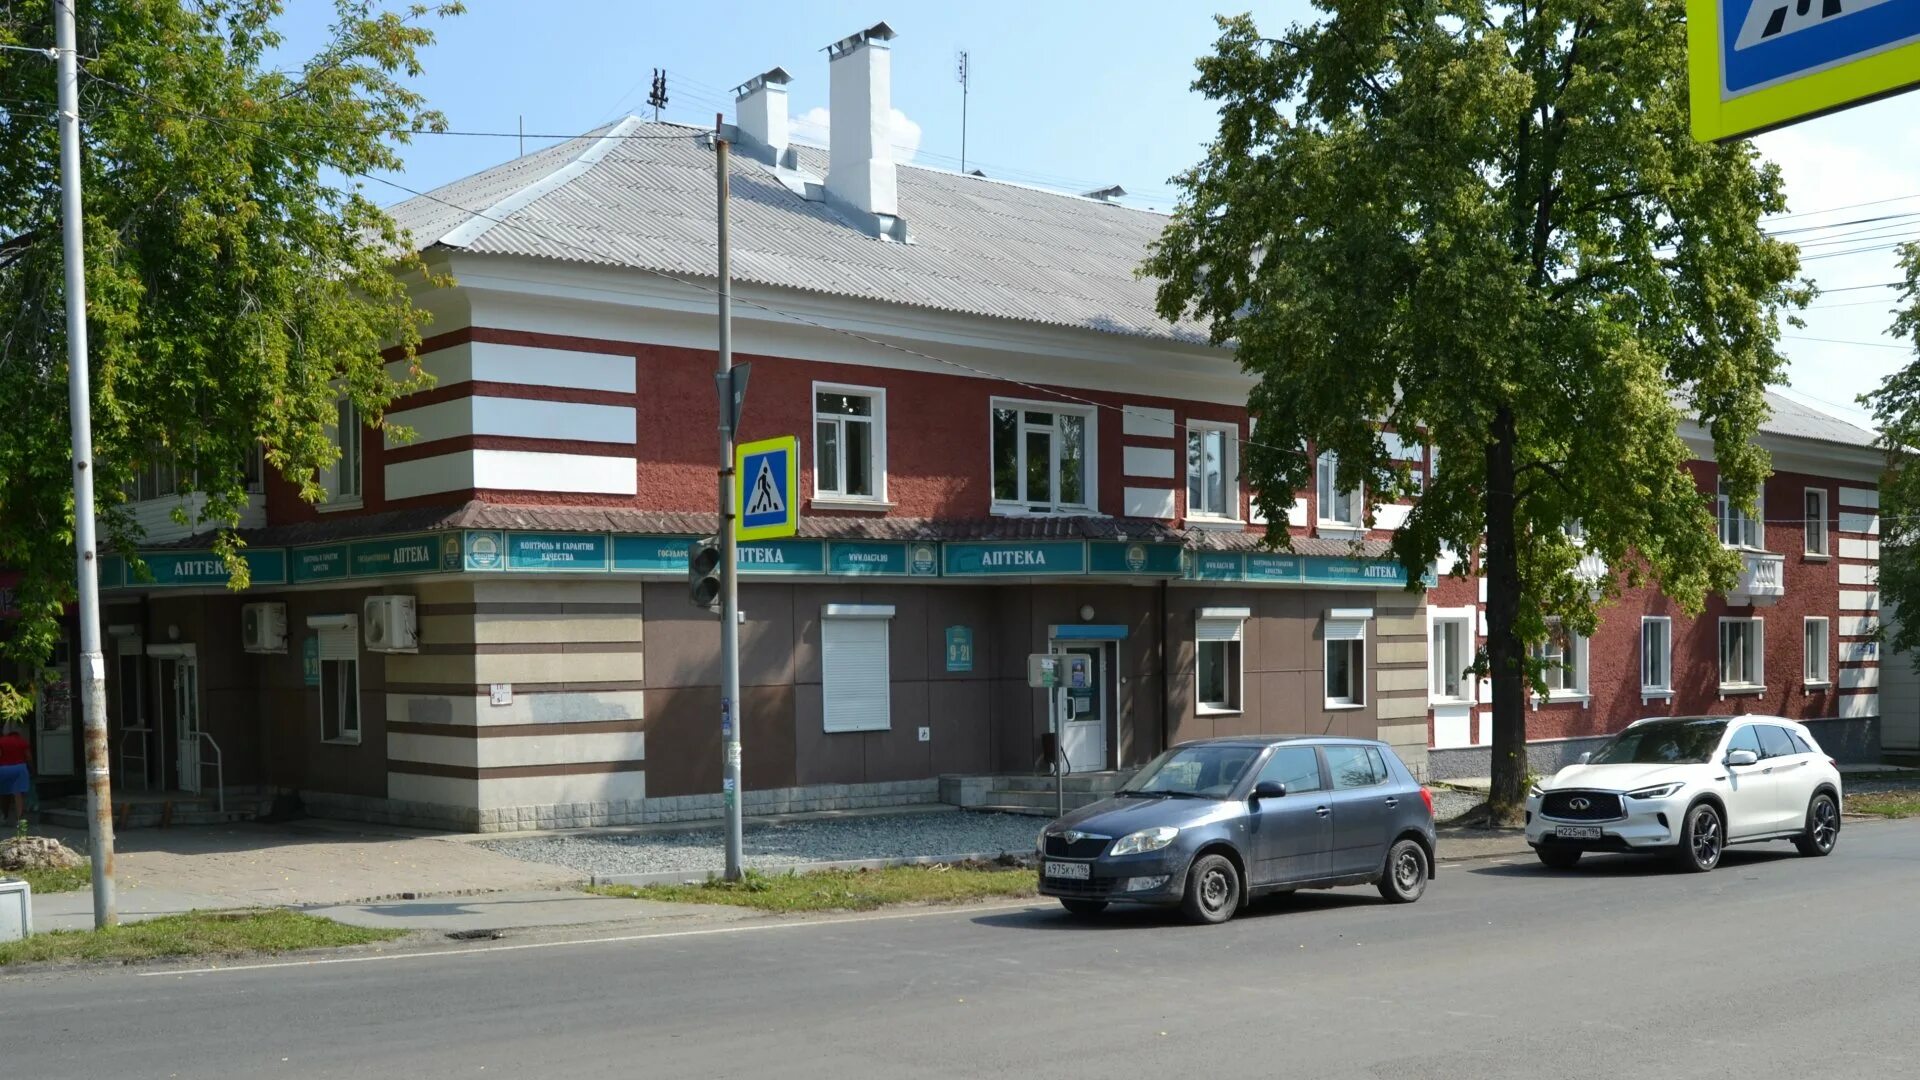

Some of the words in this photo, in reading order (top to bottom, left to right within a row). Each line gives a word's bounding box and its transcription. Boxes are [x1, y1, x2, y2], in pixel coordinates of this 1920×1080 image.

[520, 541, 554, 550] КОНТРОЛЬ
[556, 542, 560, 550] И
[563, 542, 594, 551] ГАРАНТИЯ
[393, 545, 429, 564] АПТЕКА
[541, 553, 574, 561] КАЧЕСТВА
[737, 547, 784, 563] ПТЕКА
[982, 550, 1046, 566] АПТЕКА
[174, 560, 234, 576] АПТЕК
[1364, 565, 1397, 579] АПТЕКА
[1047, 863, 1075, 875] А975КУ
[1077, 863, 1089, 874] 196
